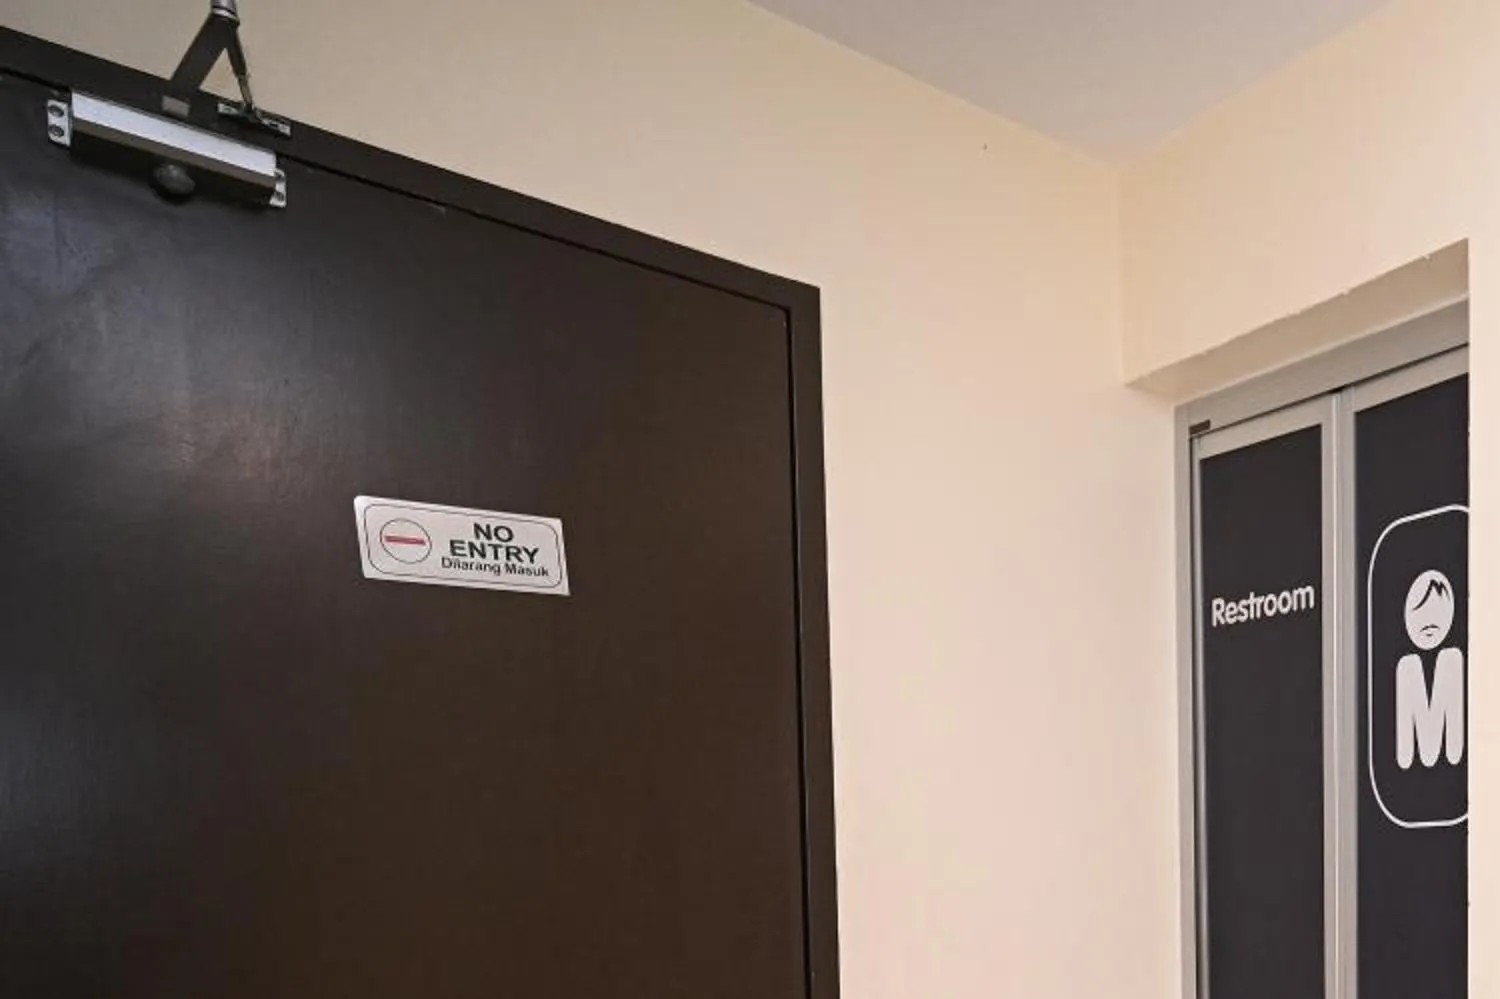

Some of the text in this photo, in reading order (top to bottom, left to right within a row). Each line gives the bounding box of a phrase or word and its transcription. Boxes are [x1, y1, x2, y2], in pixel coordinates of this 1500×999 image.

[473, 522, 515, 543] NO
[449, 539, 540, 564] ENTRY
[441, 556, 550, 578] Dilarang Masuk
[1211, 585, 1316, 628] Restroom
[1395, 647, 1465, 770] M
